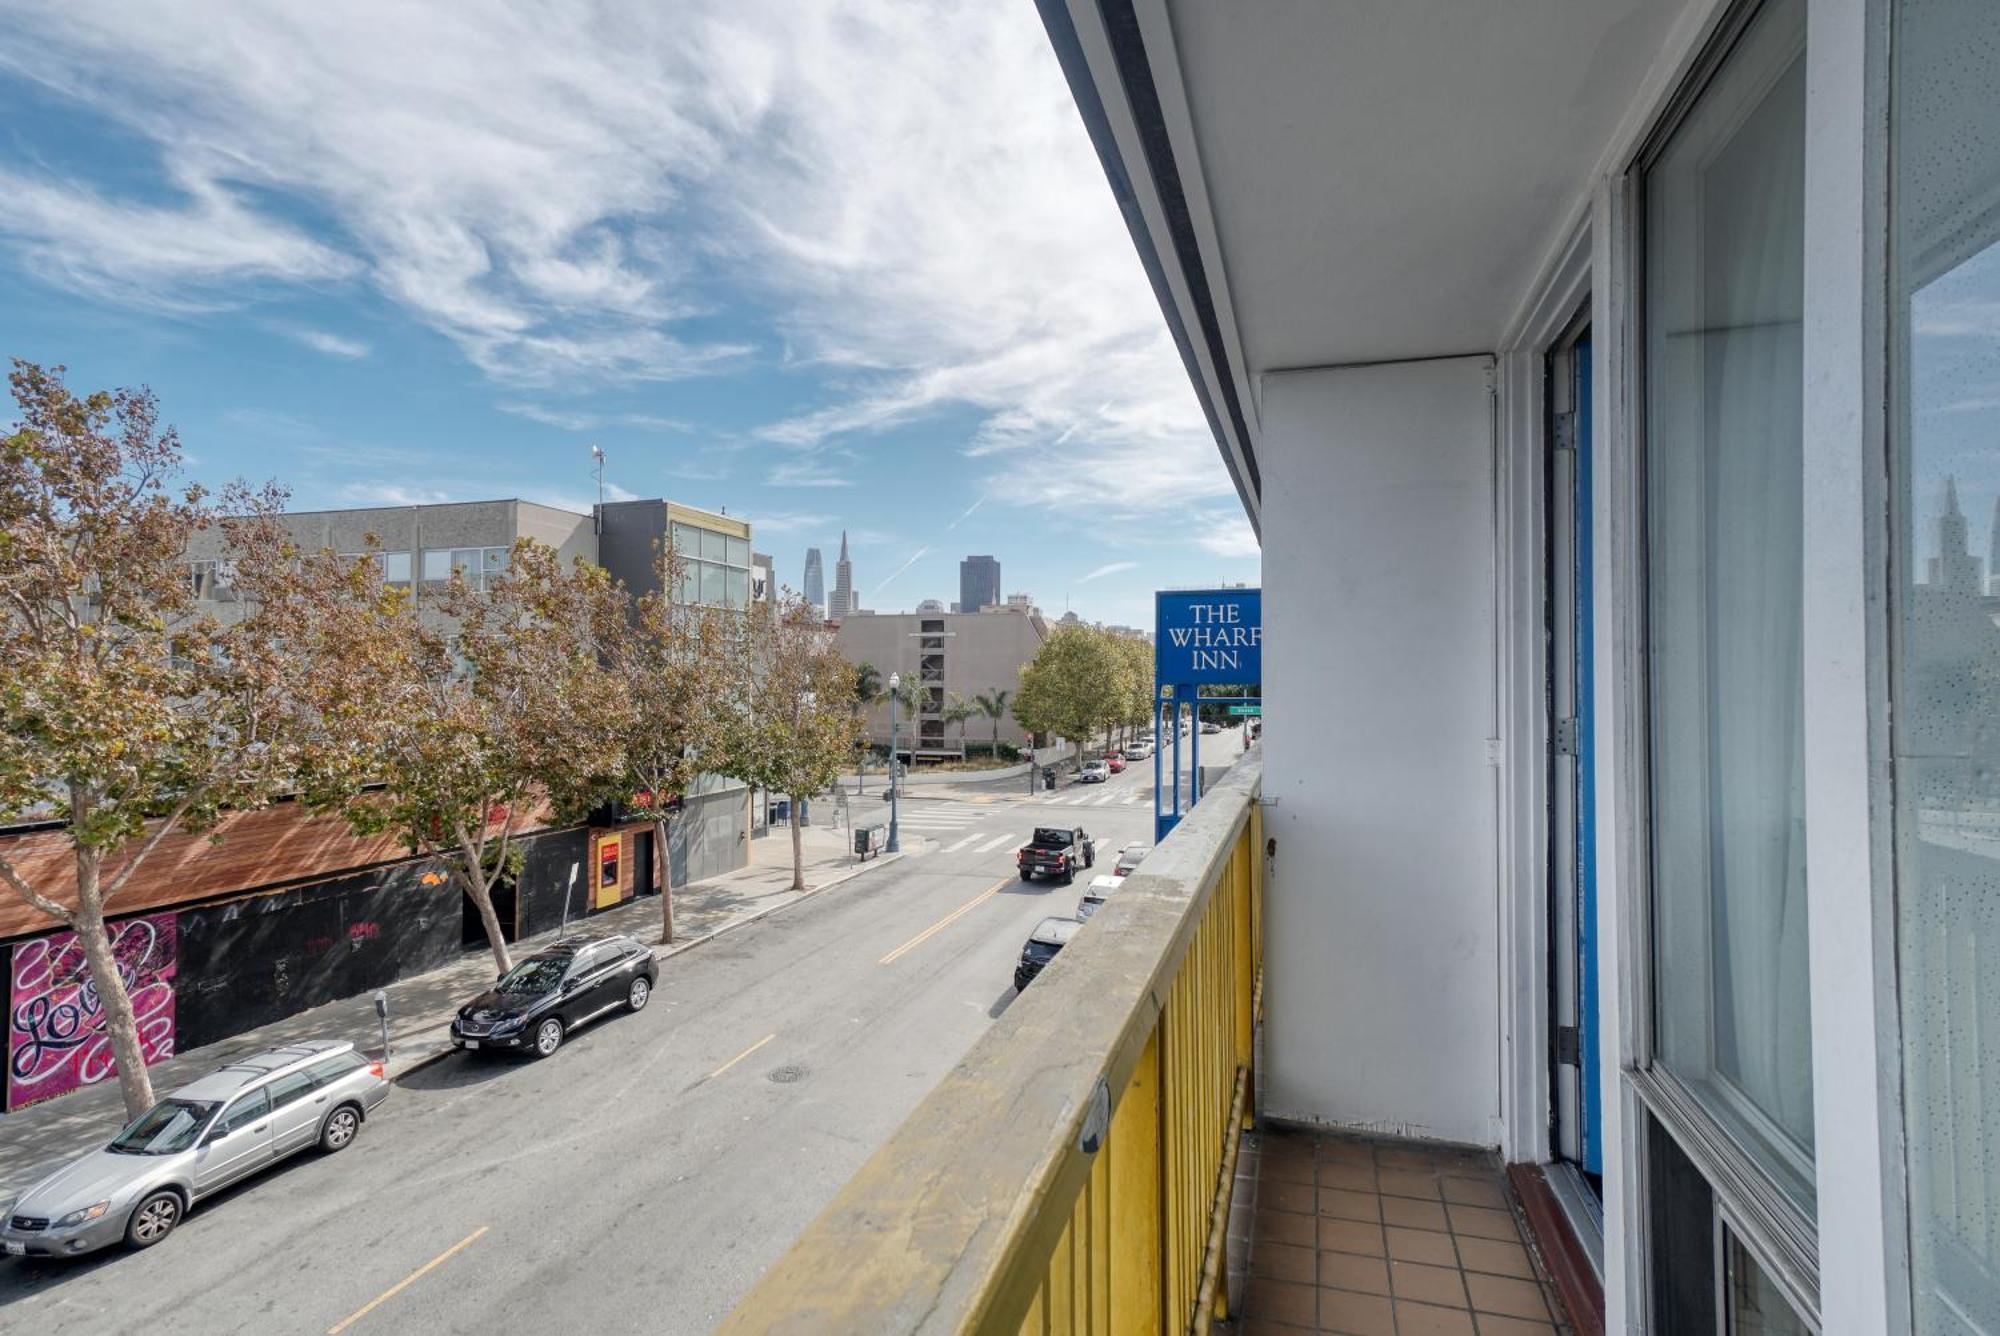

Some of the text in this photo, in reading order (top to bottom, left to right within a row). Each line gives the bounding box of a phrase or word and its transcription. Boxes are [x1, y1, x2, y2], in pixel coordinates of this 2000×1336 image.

[1189, 604, 1240, 624] THE
[1168, 626, 1262, 647] WHARF
[1192, 650, 1238, 670] INN
[12, 961, 136, 1078] Lov
